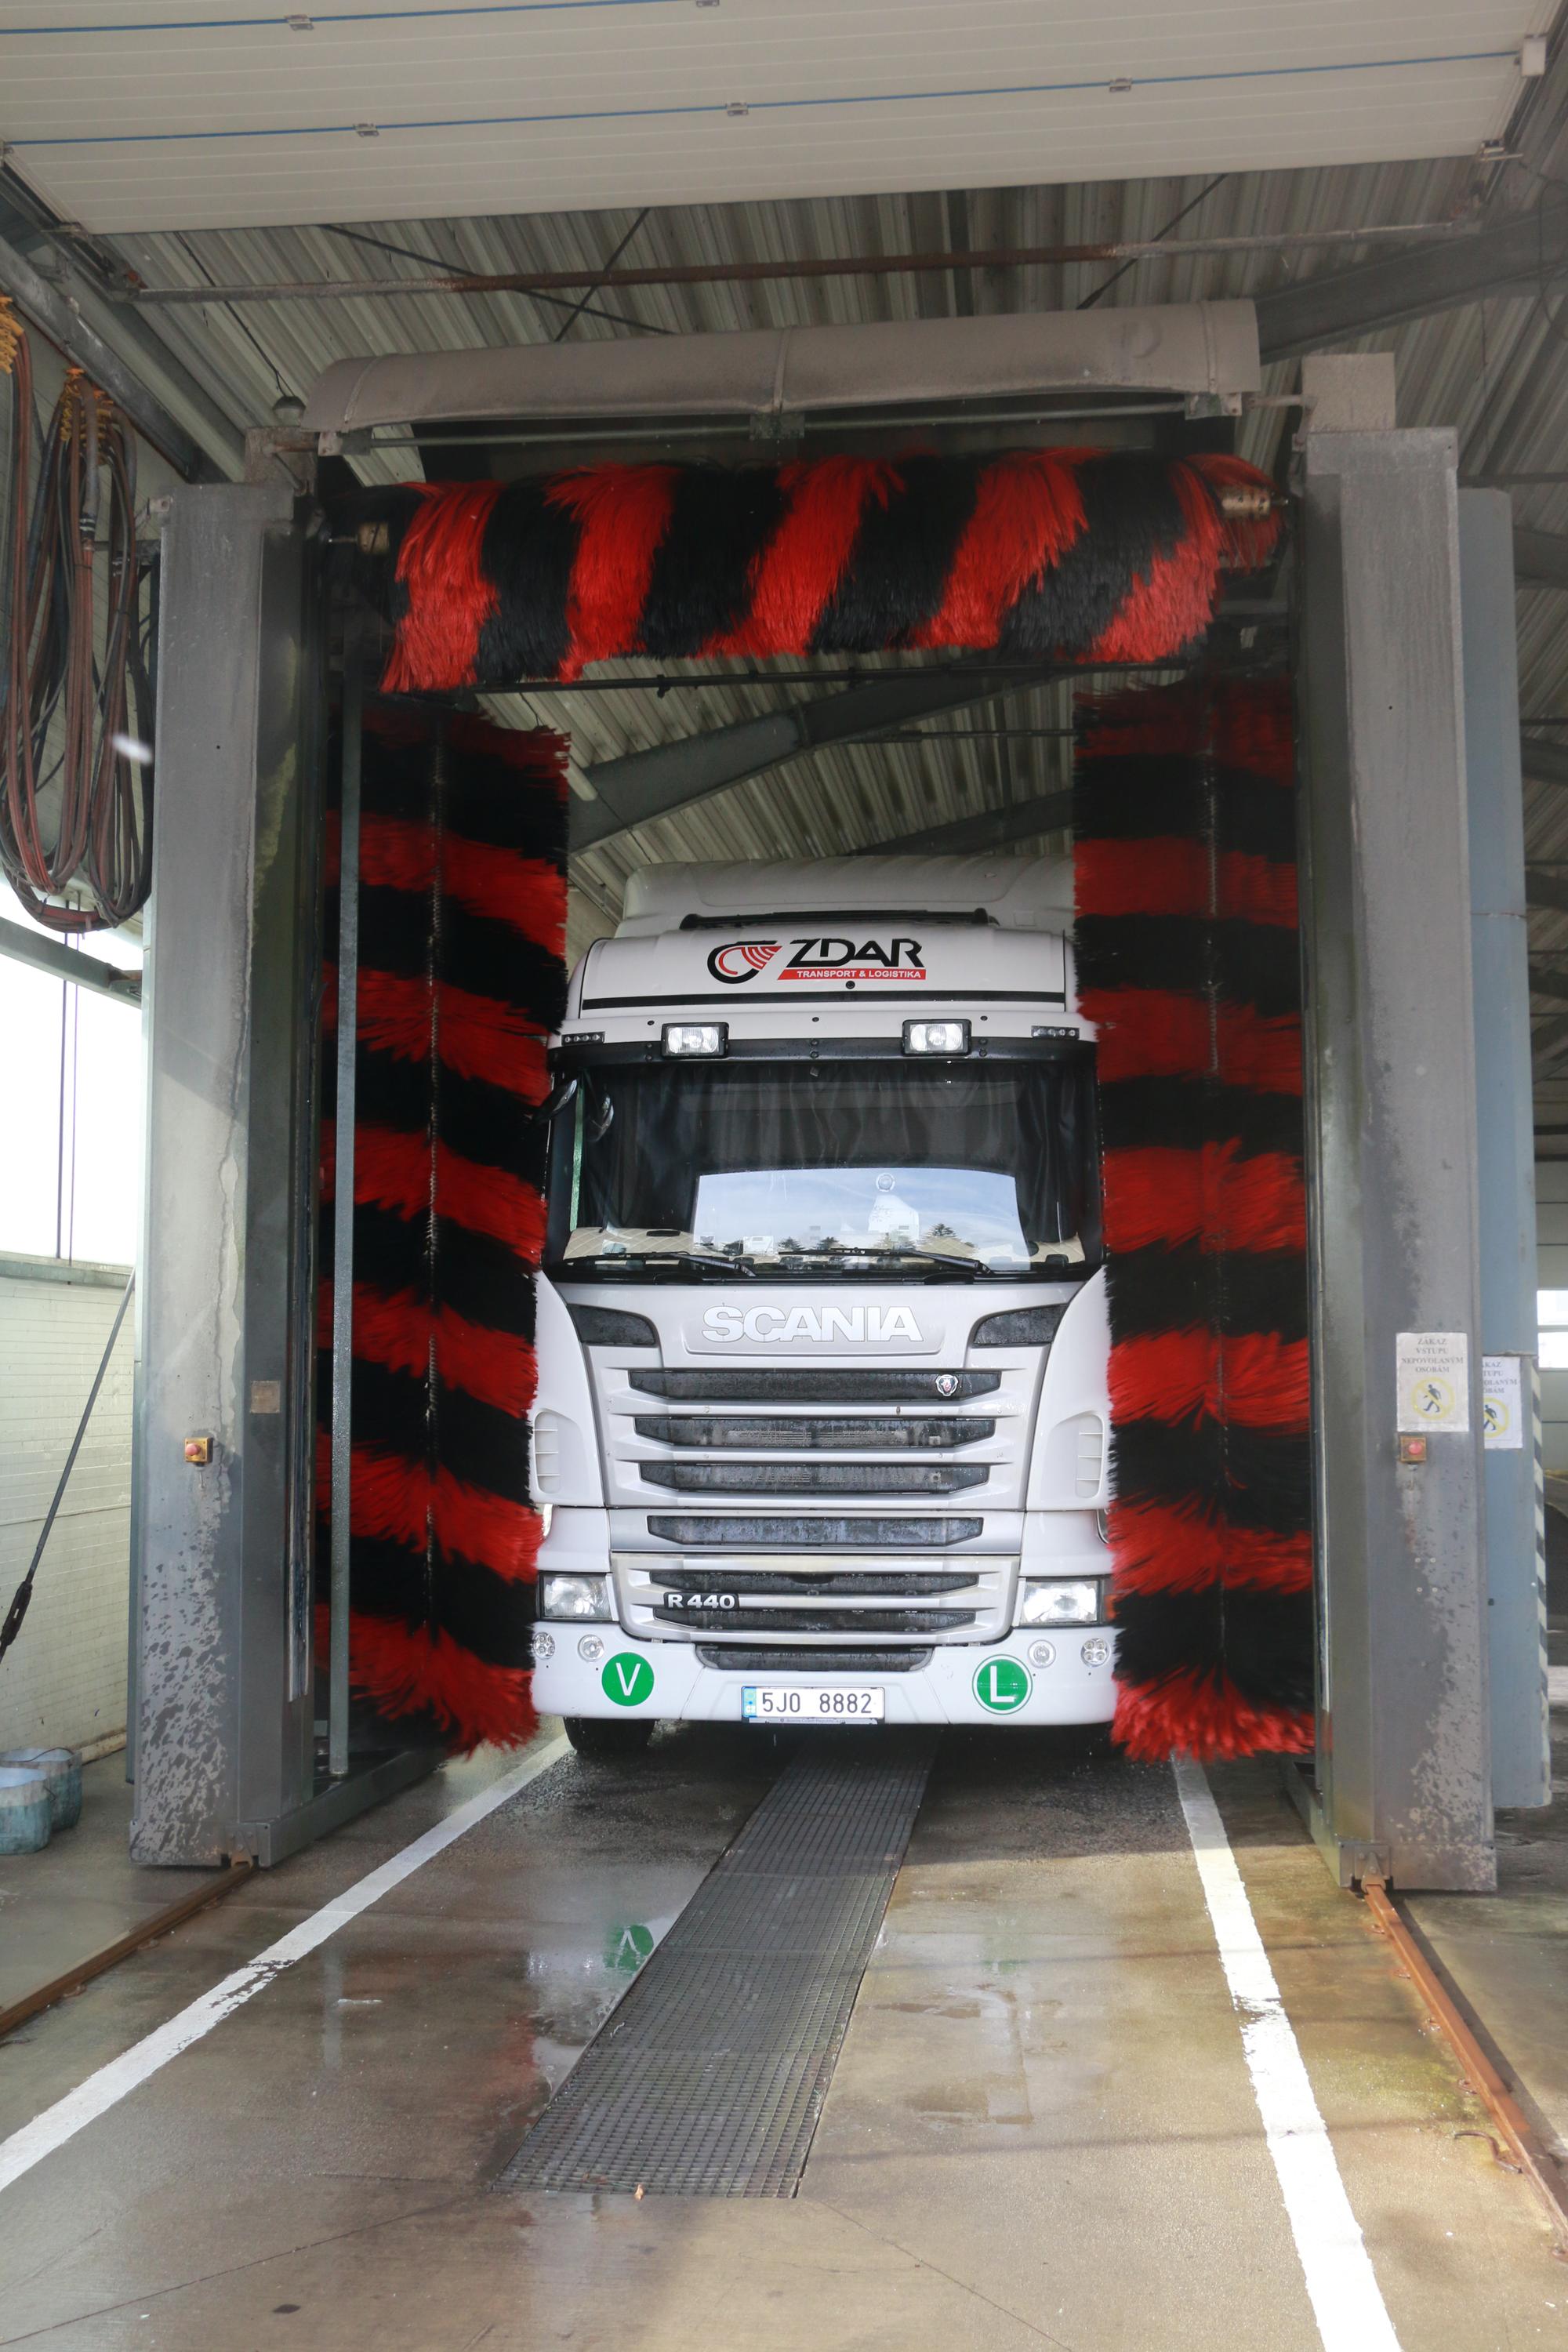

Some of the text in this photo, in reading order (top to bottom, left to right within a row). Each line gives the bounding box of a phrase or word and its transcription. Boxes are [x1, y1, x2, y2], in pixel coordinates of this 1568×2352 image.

[786, 938, 924, 968] ZDAR
[797, 970, 857, 978] TRANSPORT
[868, 970, 921, 978] LOGISTIKA
[701, 1305, 924, 1343] SCANIA
[667, 1594, 735, 1609] R 440
[615, 1662, 641, 1696] V
[989, 1665, 1015, 1703] L
[762, 1692, 800, 1713] 5J0
[819, 1693, 872, 1714] 8882
